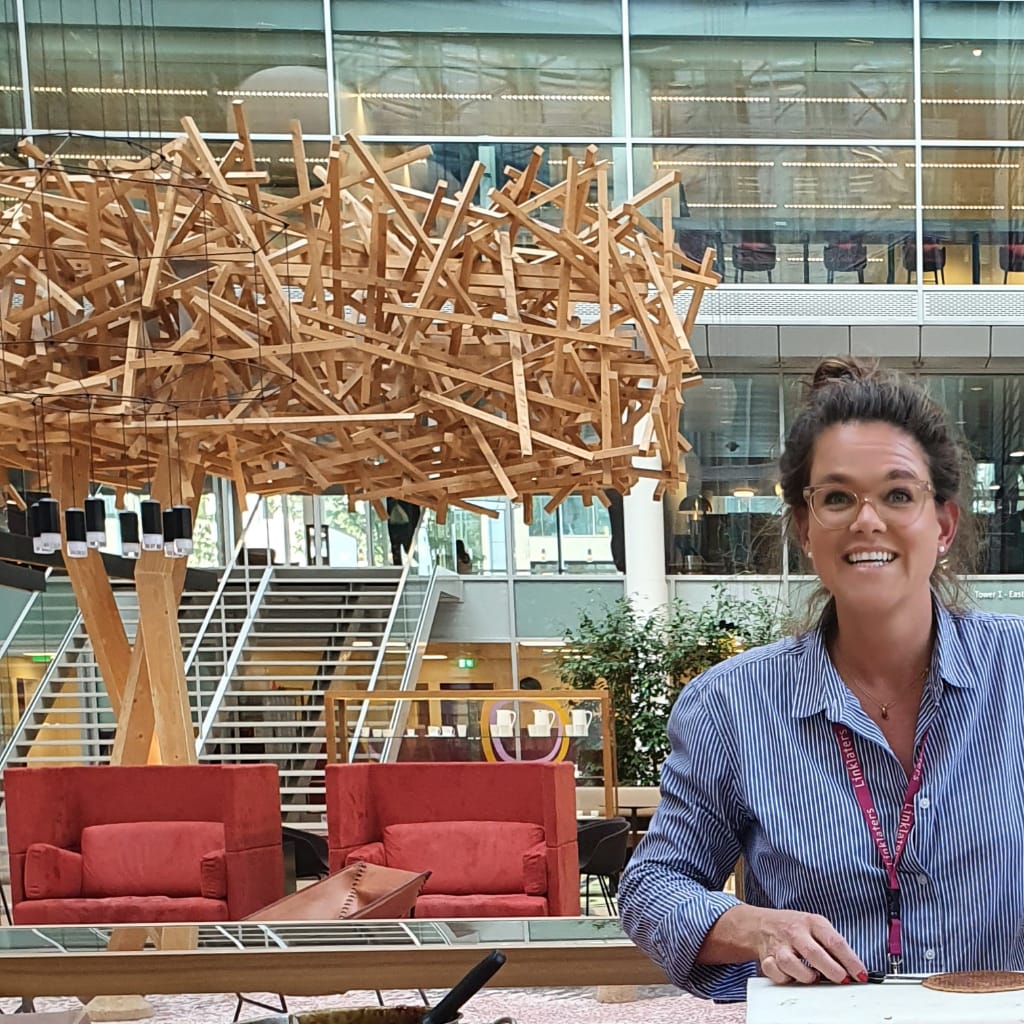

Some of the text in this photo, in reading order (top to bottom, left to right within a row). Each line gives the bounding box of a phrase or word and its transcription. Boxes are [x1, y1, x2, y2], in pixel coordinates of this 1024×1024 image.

[974, 590, 996, 600] Tower
[1008, 590, 1024, 599] East
[839, 728, 865, 788] Linklaters
